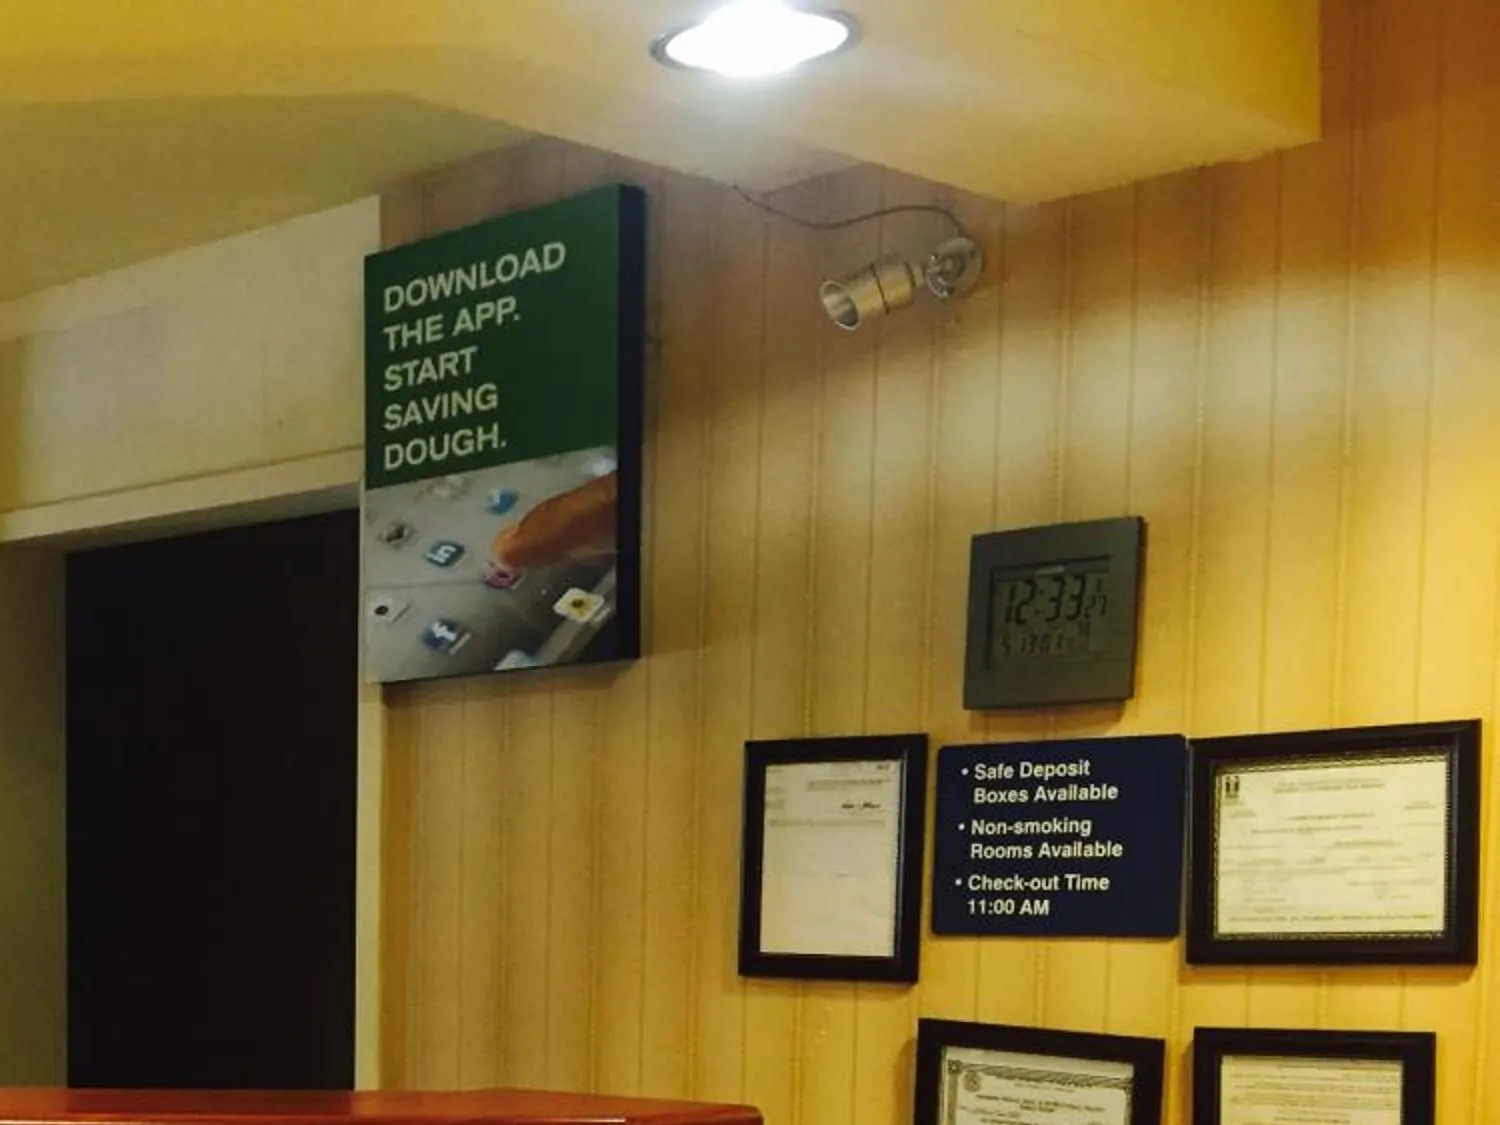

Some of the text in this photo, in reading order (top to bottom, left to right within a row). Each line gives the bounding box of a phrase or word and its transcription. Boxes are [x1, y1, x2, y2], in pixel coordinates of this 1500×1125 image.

[383, 241, 566, 313] DOWNLOAD
[383, 297, 520, 351] THE APP.
[383, 346, 479, 391] START
[383, 383, 498, 430] SAVING
[383, 422, 507, 470] DOUGH.
[1005, 574, 1086, 625] 12:33
[974, 759, 1090, 782] Safe Deposit
[973, 783, 1118, 804] Boxes Available
[971, 816, 1092, 838] Non-smoking
[970, 839, 1123, 860] Rooms Available
[968, 872, 1110, 893] Check-out Time
[968, 898, 1050, 916] 11:00 AM
